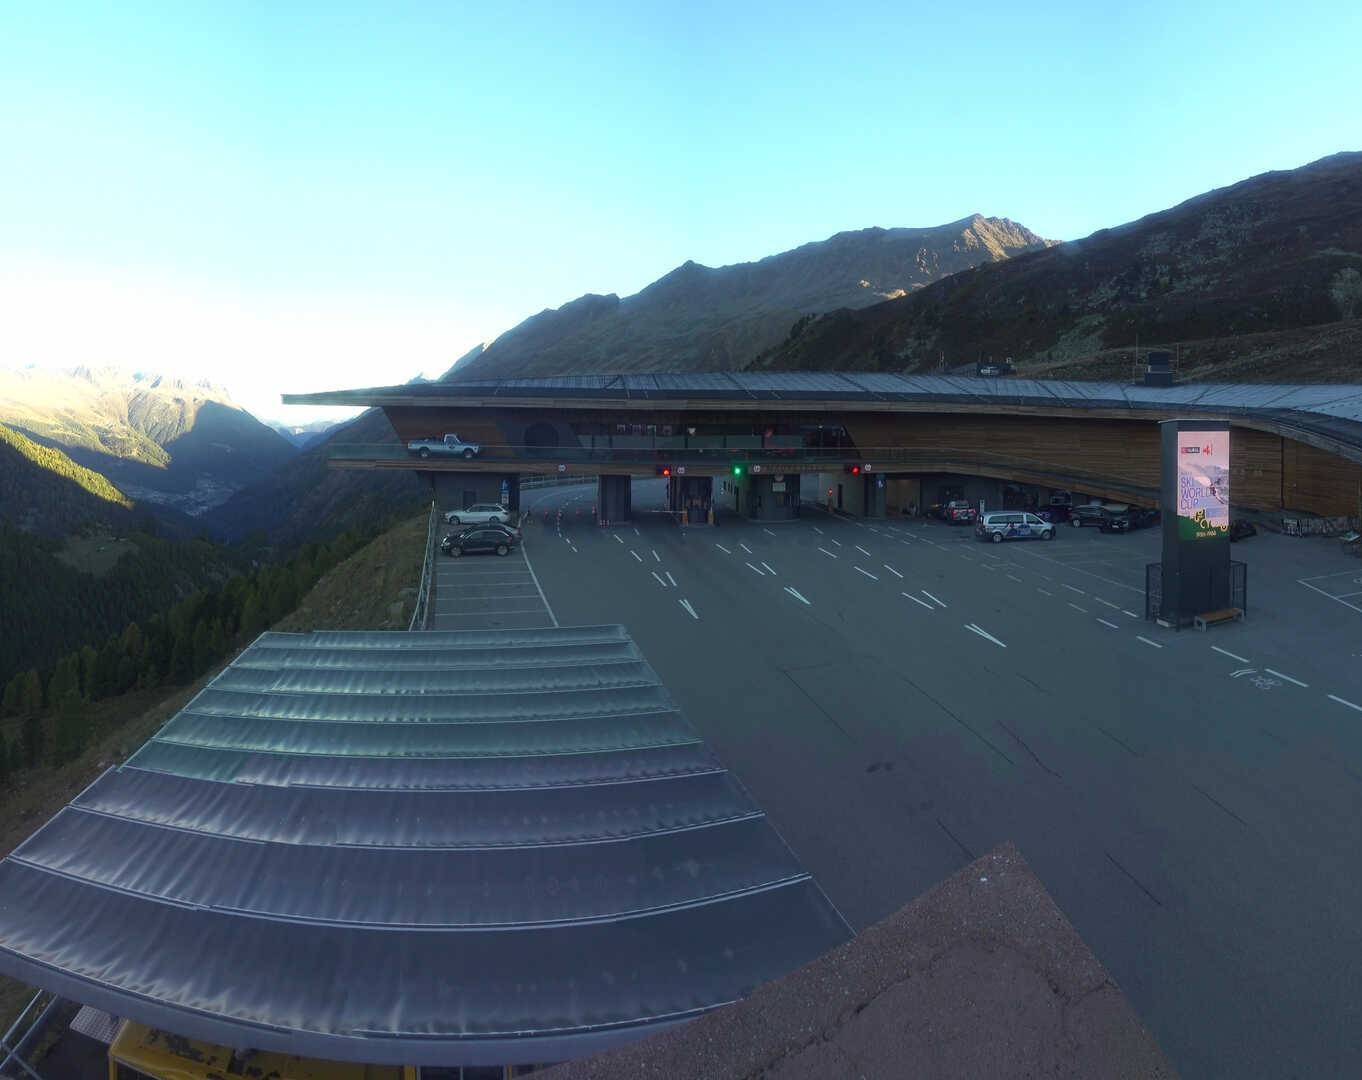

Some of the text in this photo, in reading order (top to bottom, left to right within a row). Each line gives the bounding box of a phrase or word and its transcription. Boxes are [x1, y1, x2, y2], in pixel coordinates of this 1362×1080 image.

[1181, 476, 1194, 488] SKI
[1181, 487, 1210, 499] WORLD
[1181, 498, 1199, 510] CUP
